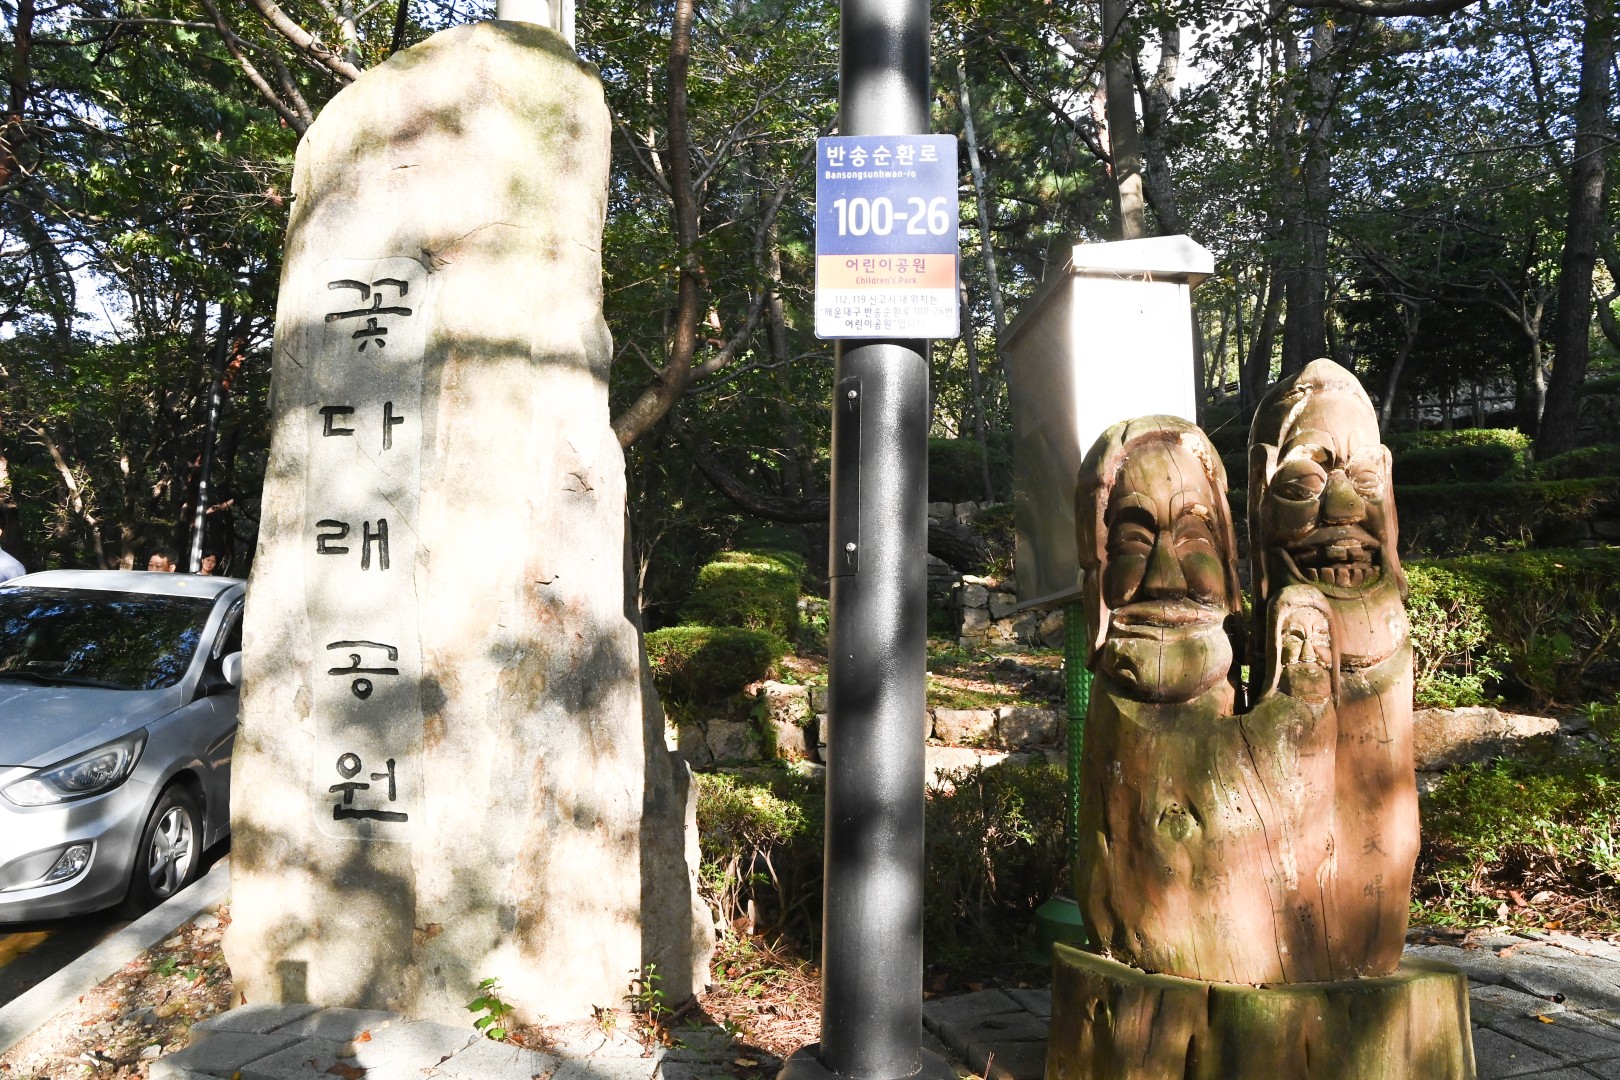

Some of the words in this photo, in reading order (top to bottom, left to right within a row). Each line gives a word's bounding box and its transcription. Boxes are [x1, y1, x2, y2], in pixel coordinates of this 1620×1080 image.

[826, 144, 938, 167] 반송순환로
[825, 170, 916, 180] Bansongsunhwan-ro
[833, 197, 950, 236] 100-26
[845, 258, 925, 274] 어린이공원
[855, 276, 896, 285] Children's
[898, 276, 917, 284] Park
[868, 294, 896, 306] 신고시
[910, 294, 938, 306] 위치는
[864, 307, 910, 319] 반송순환로
[315, 278, 413, 822] 꽃다래공원
